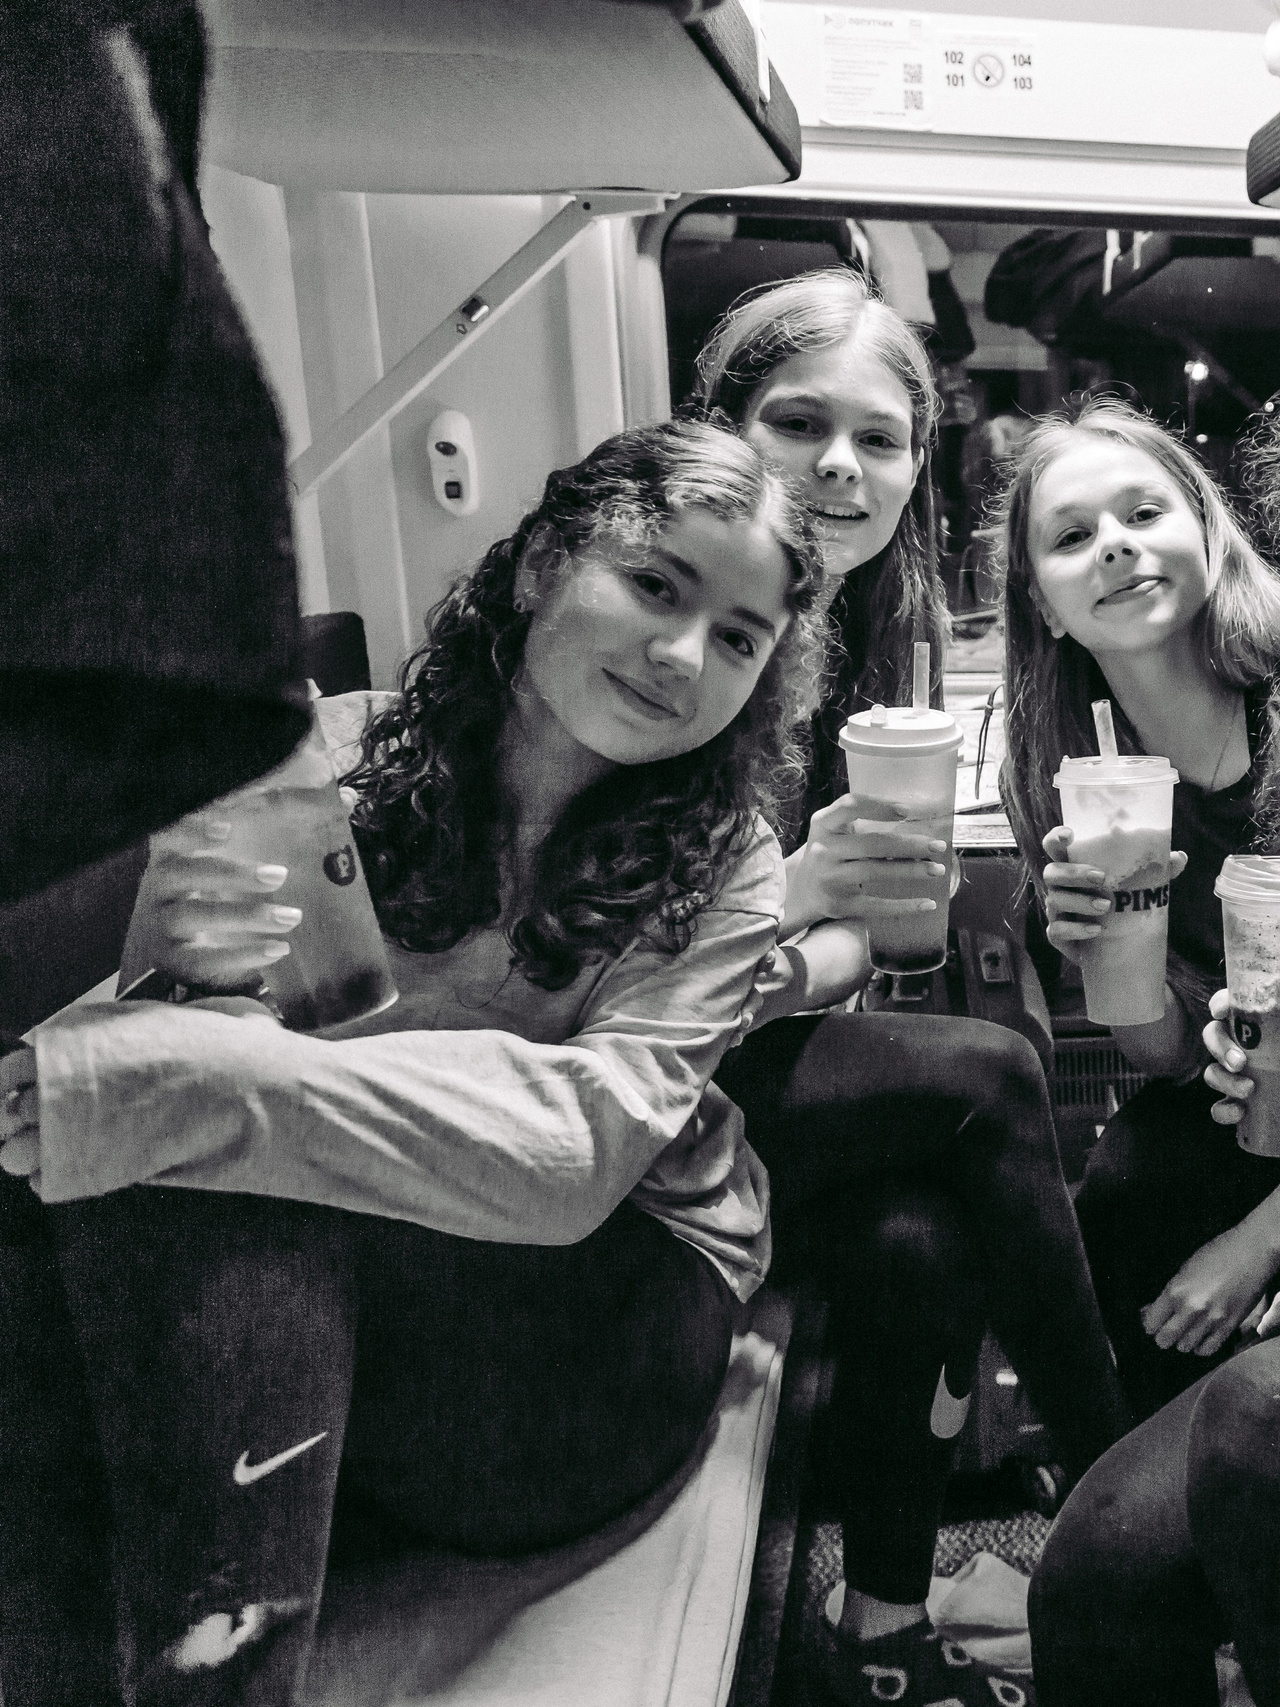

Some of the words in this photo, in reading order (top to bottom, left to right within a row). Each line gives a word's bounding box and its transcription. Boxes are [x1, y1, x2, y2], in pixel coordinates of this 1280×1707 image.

[944, 51, 964, 64] 102
[1012, 54, 1032, 67] 104
[946, 74, 965, 87] 101
[1014, 77, 1033, 90] 103
[1113, 884, 1169, 912] PIMS
